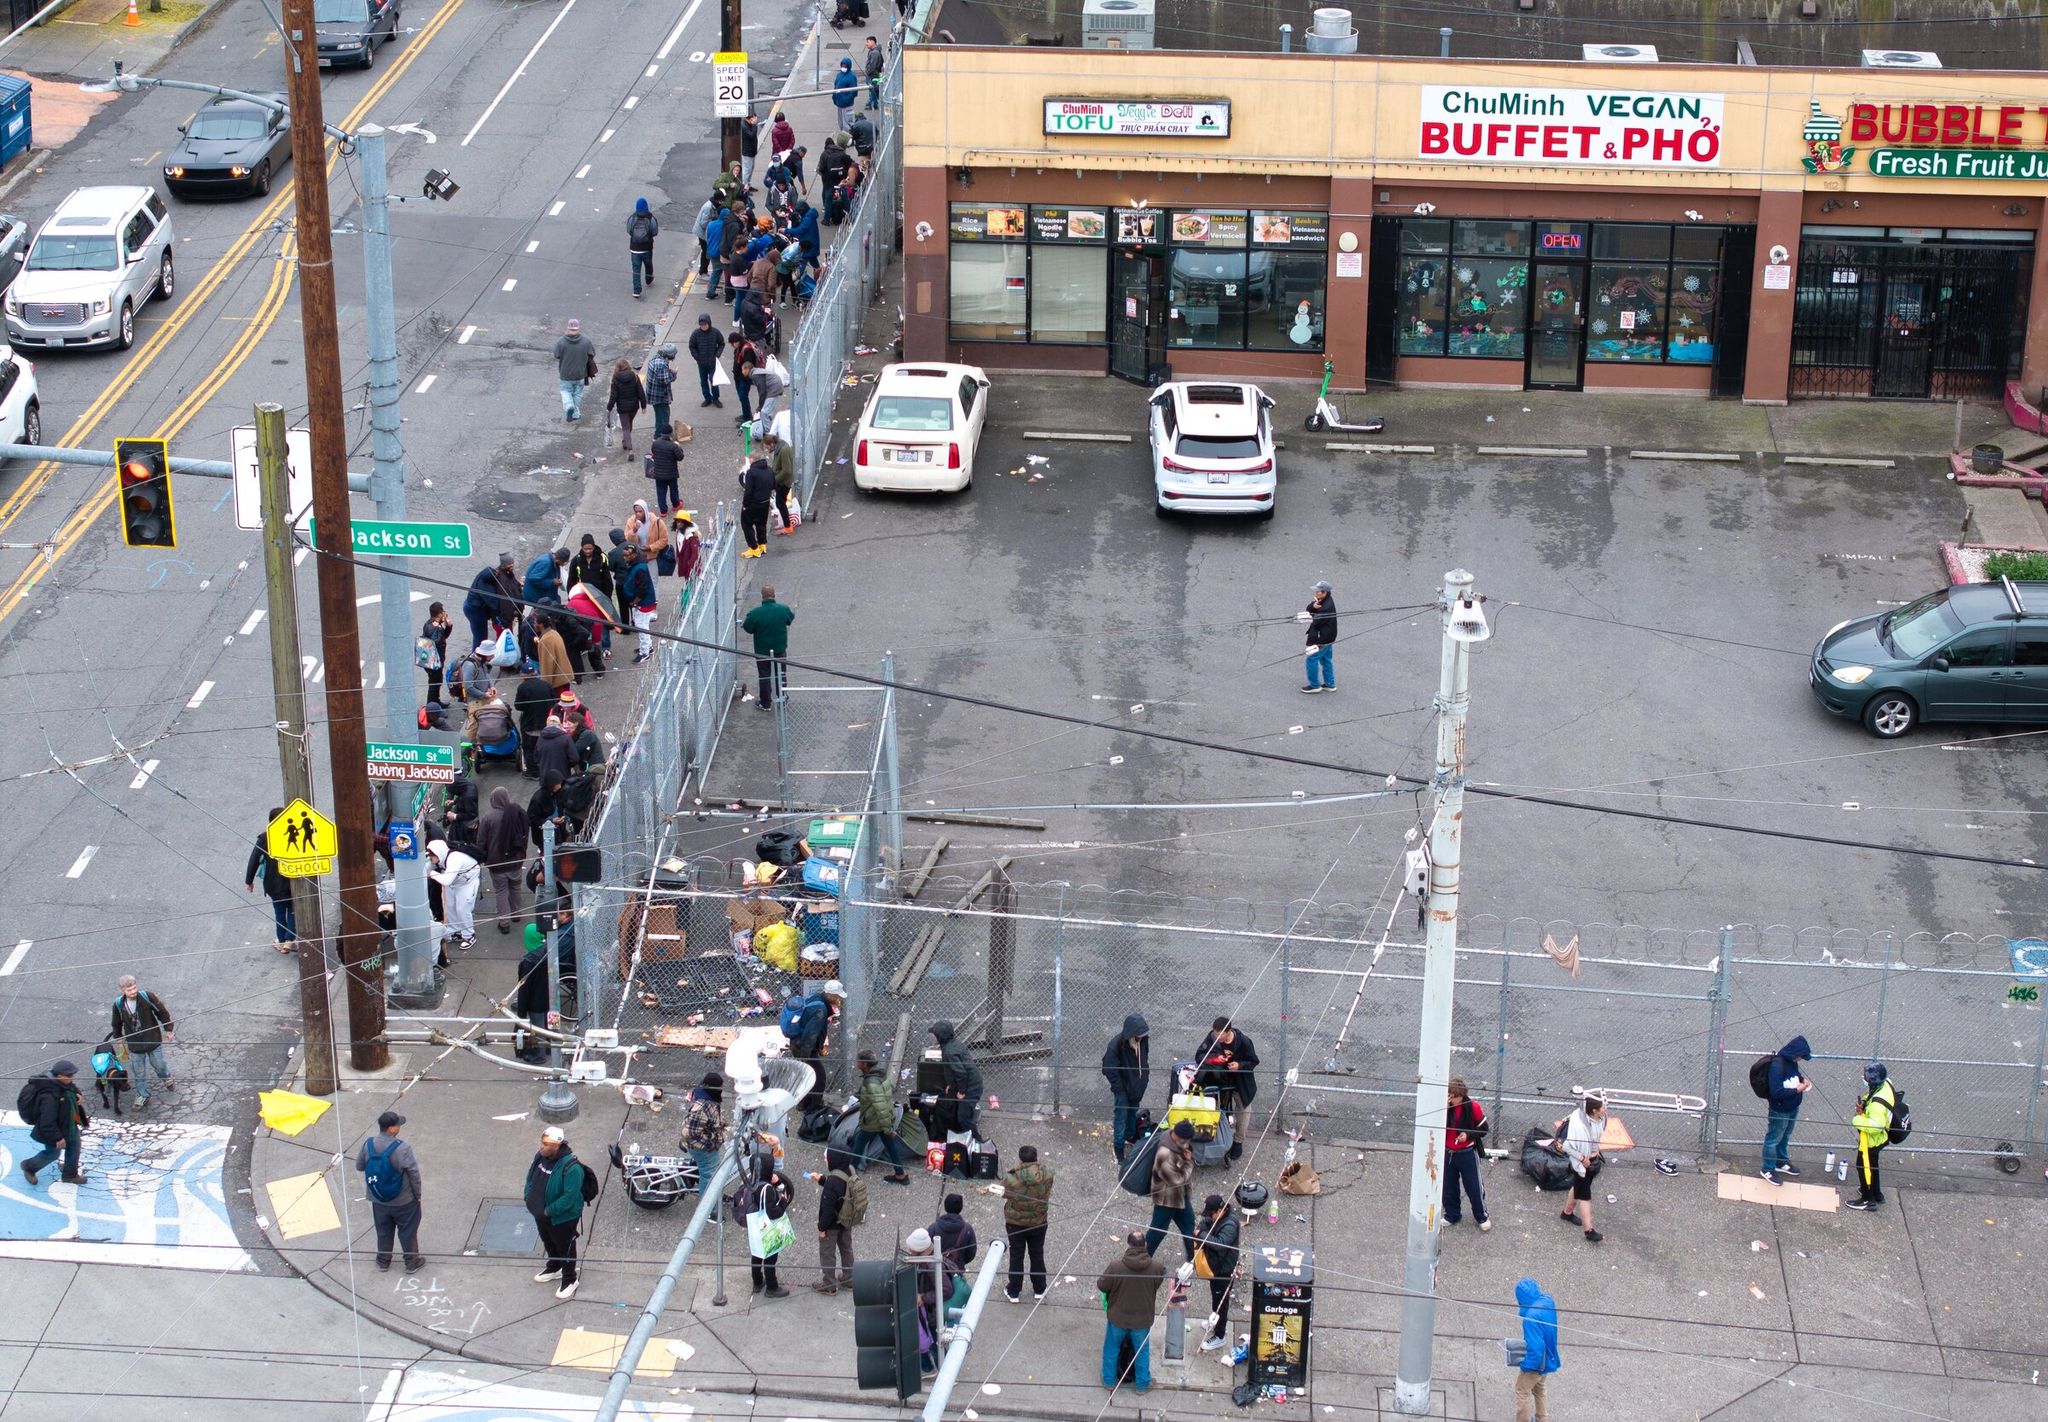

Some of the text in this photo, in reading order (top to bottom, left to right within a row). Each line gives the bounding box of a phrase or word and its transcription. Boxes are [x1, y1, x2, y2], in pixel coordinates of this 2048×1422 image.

[716, 66, 745, 74] SPEED
[719, 86, 743, 100] 20
[1062, 103, 1104, 115] ChuMinh
[1443, 90, 1701, 119] ChuMinh VEGAN
[1117, 102, 1194, 121] Veggie Deli
[1052, 114, 1113, 131] TOFU
[1167, 125, 1190, 133] CHAY
[1850, 103, 2025, 145] BUBBLE
[1420, 116, 1721, 162] BUFFET & PHỞ
[1876, 151, 1947, 175] Fresh
[1955, 153, 2015, 177] Fruit
[957, 225, 983, 233] Combo
[1218, 223, 1238, 232] Spicy
[1041, 231, 1059, 239] Soup
[1144, 236, 1158, 244] Tea
[1210, 231, 1246, 239] Vermicelli
[1291, 234, 1326, 242] sandwich
[1543, 234, 1580, 247] OPEN
[250, 464, 296, 479] TN
[443, 535, 461, 550] St
[367, 744, 418, 761] Jackson
[426, 751, 437, 762] St
[367, 762, 453, 781] Đường Jackson
[281, 861, 328, 874] SCHOOL
[1264, 1305, 1298, 1315] Garbage
